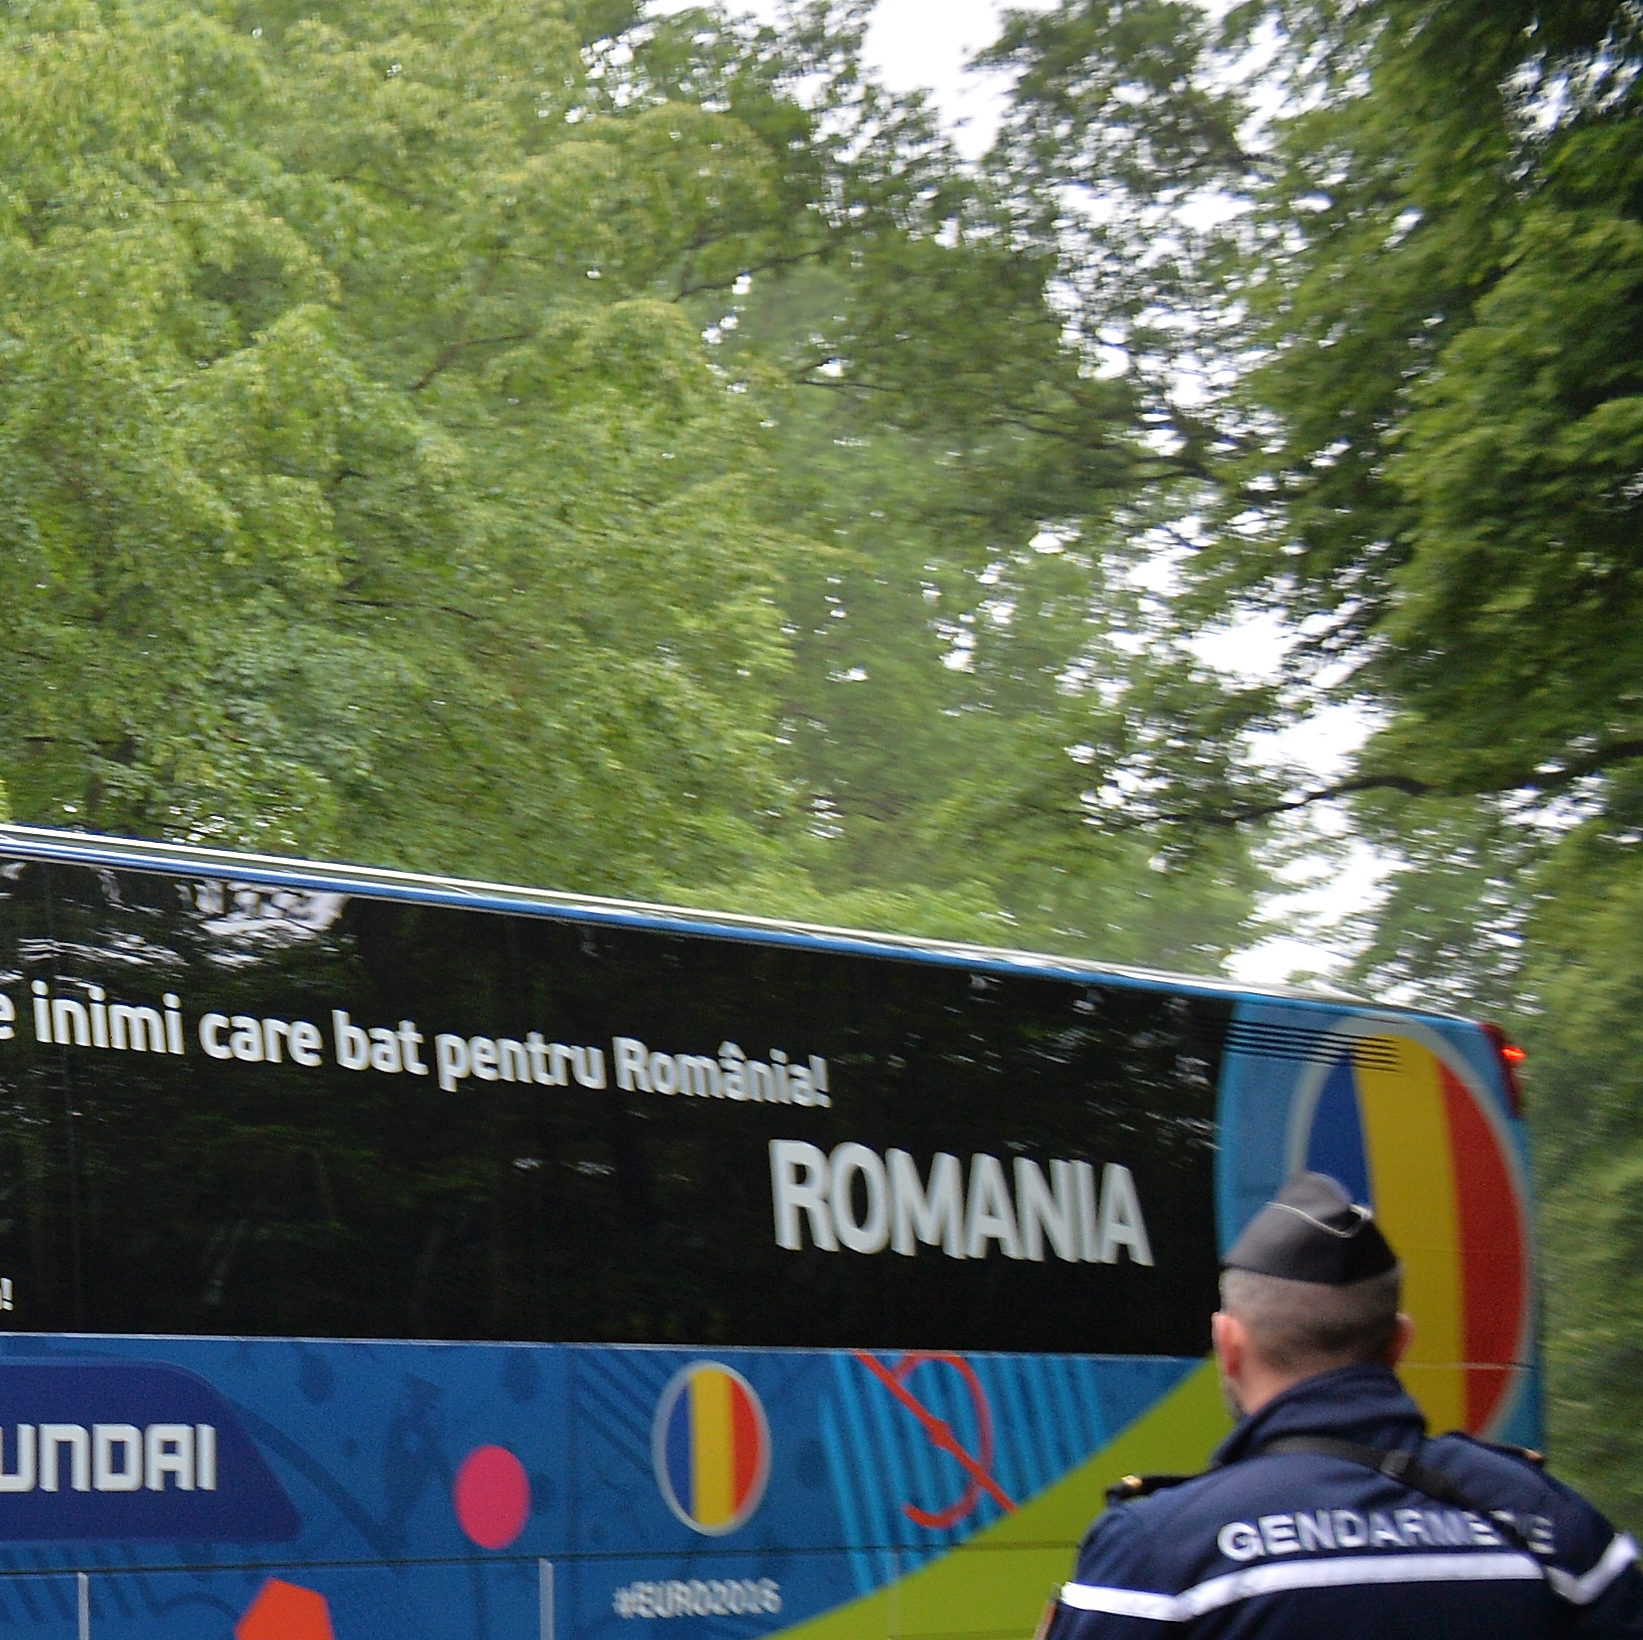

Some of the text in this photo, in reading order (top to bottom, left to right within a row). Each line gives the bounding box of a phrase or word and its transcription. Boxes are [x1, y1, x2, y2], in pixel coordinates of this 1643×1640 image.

[31, 978, 185, 1056] inimi
[198, 1011, 323, 1068] care
[331, 1008, 429, 1076] bat
[435, 1030, 607, 1093] pentru
[611, 1036, 833, 1109] România!
[768, 1138, 1155, 1267] ROMANIA
[1216, 1507, 1556, 1562] GENDARMEE
